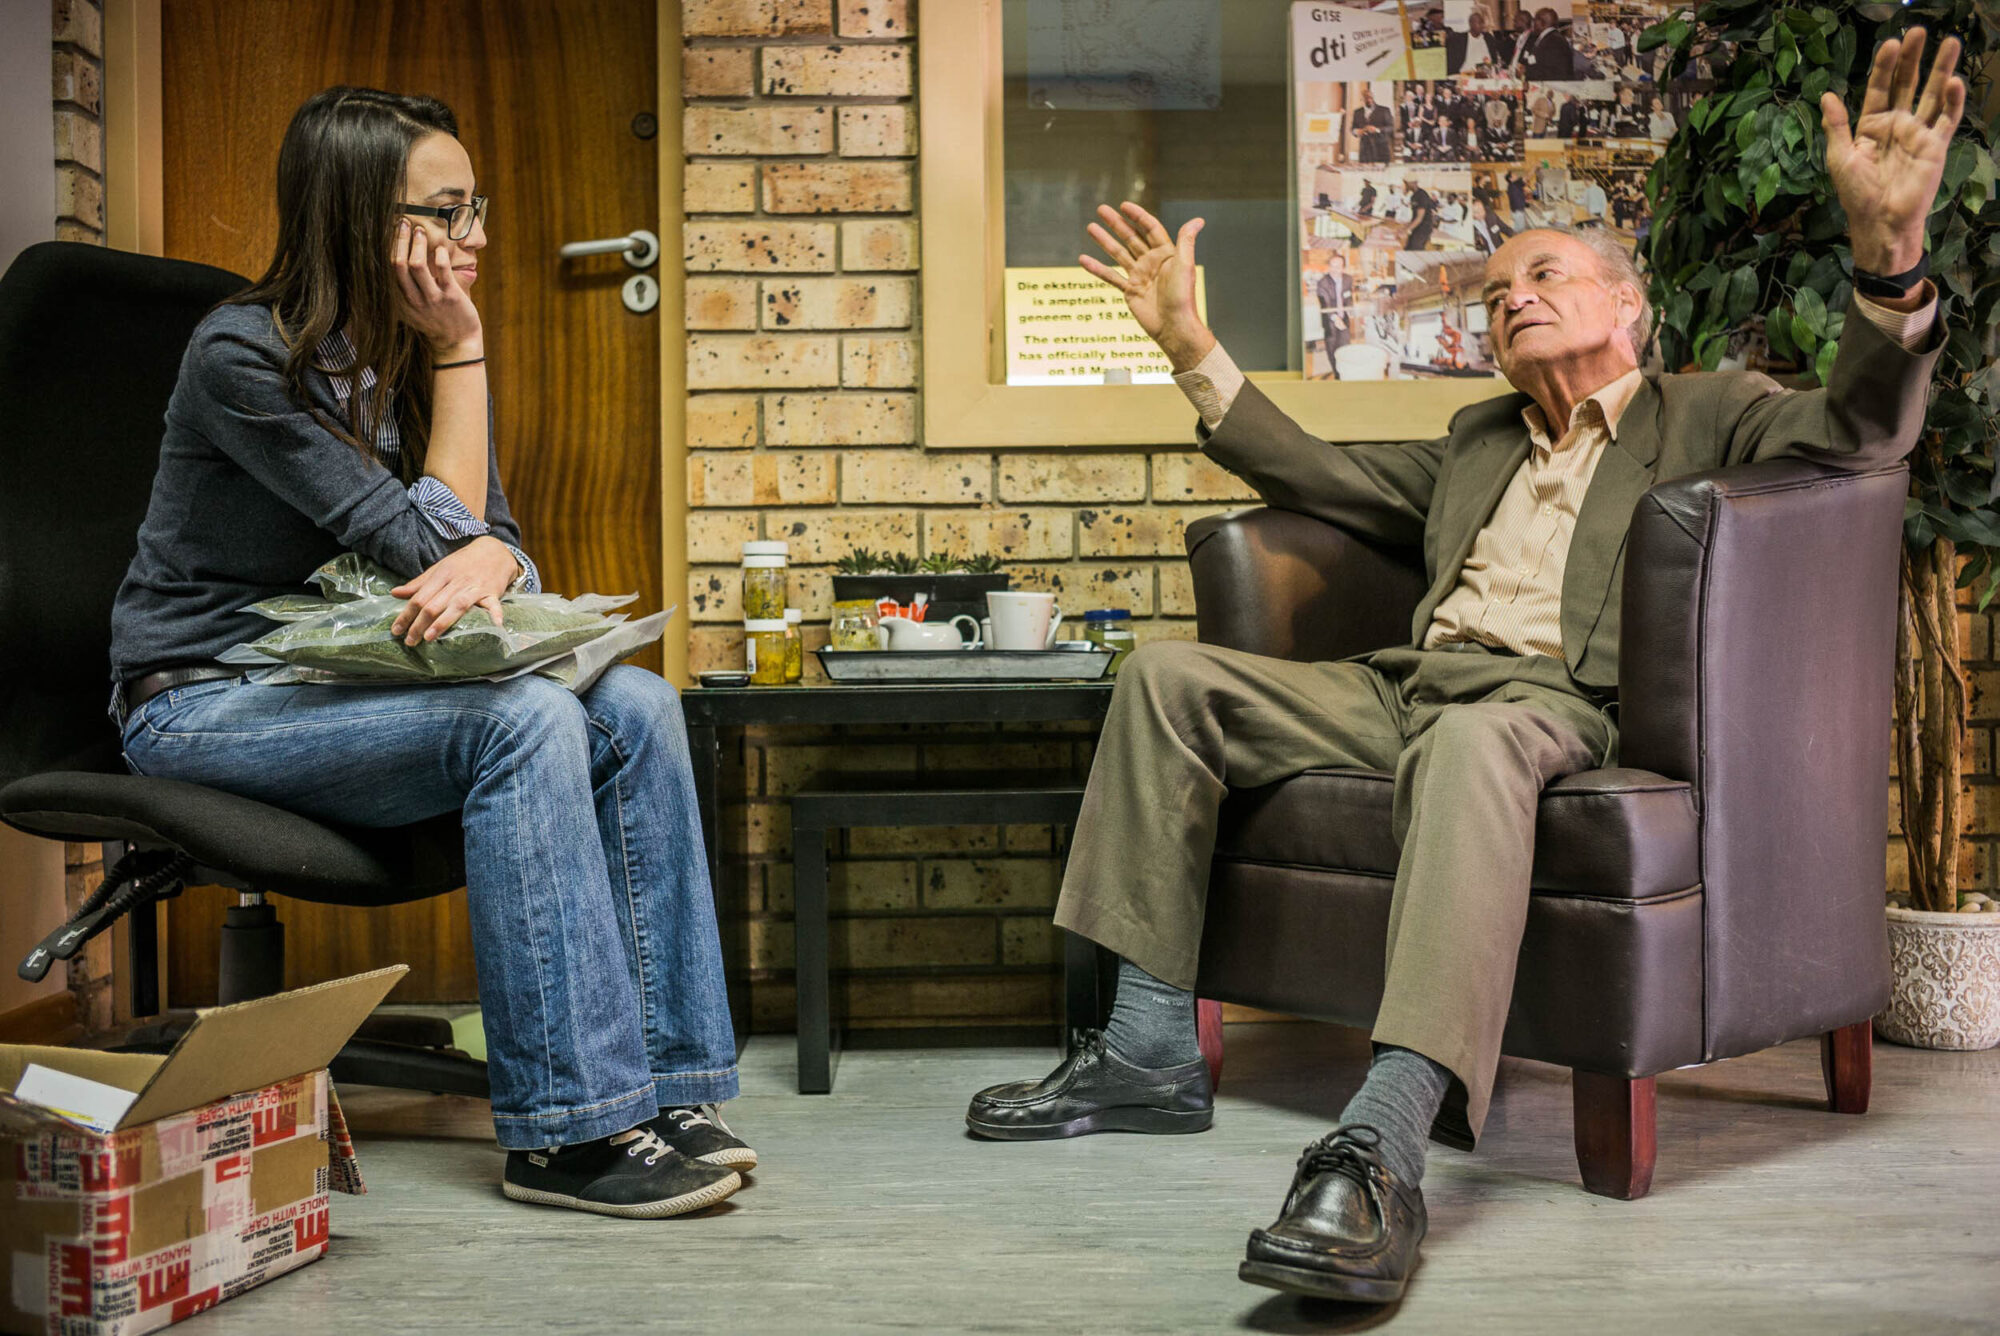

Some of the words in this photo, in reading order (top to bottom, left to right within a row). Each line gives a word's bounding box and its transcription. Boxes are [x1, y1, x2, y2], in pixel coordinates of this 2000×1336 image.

[1310, 34, 1346, 68] dti
[1017, 281, 1039, 291] Die
[1043, 281, 1111, 291] ekstrusie
[1032, 297, 1044, 306] is
[1048, 296, 1106, 308] amptelik
[1018, 313, 1072, 324] geneem
[1076, 313, 1093, 324] op
[1098, 312, 1113, 321] 18
[1024, 335, 1048, 344] The
[1053, 334, 1117, 344] extrusion
[1121, 334, 1155, 343] labo
[1018, 351, 1043, 361] has
[1047, 350, 1105, 362] officially
[1110, 350, 1143, 359] been
[1048, 367, 1065, 376] on
[1069, 366, 1085, 375] 18
[1137, 365, 1170, 374] 2010
[228, 1100, 255, 1116] WITH
[225, 1125, 251, 1137] LIMITED
[208, 1133, 251, 1150] TECHNOLOGY
[273, 1205, 297, 1223] WITH
[241, 1219, 294, 1243] LUTON-ENGLAND
[268, 1230, 294, 1244] LIMITED
[146, 1243, 191, 1270] HANDLE
[252, 1239, 293, 1259] TECHNOLOGY
[246, 1247, 293, 1270] MEASUREMENT
[49, 1242, 60, 1305] HANDLE
[111, 1260, 142, 1280] WITH
[104, 1288, 137, 1304] LIMITED
